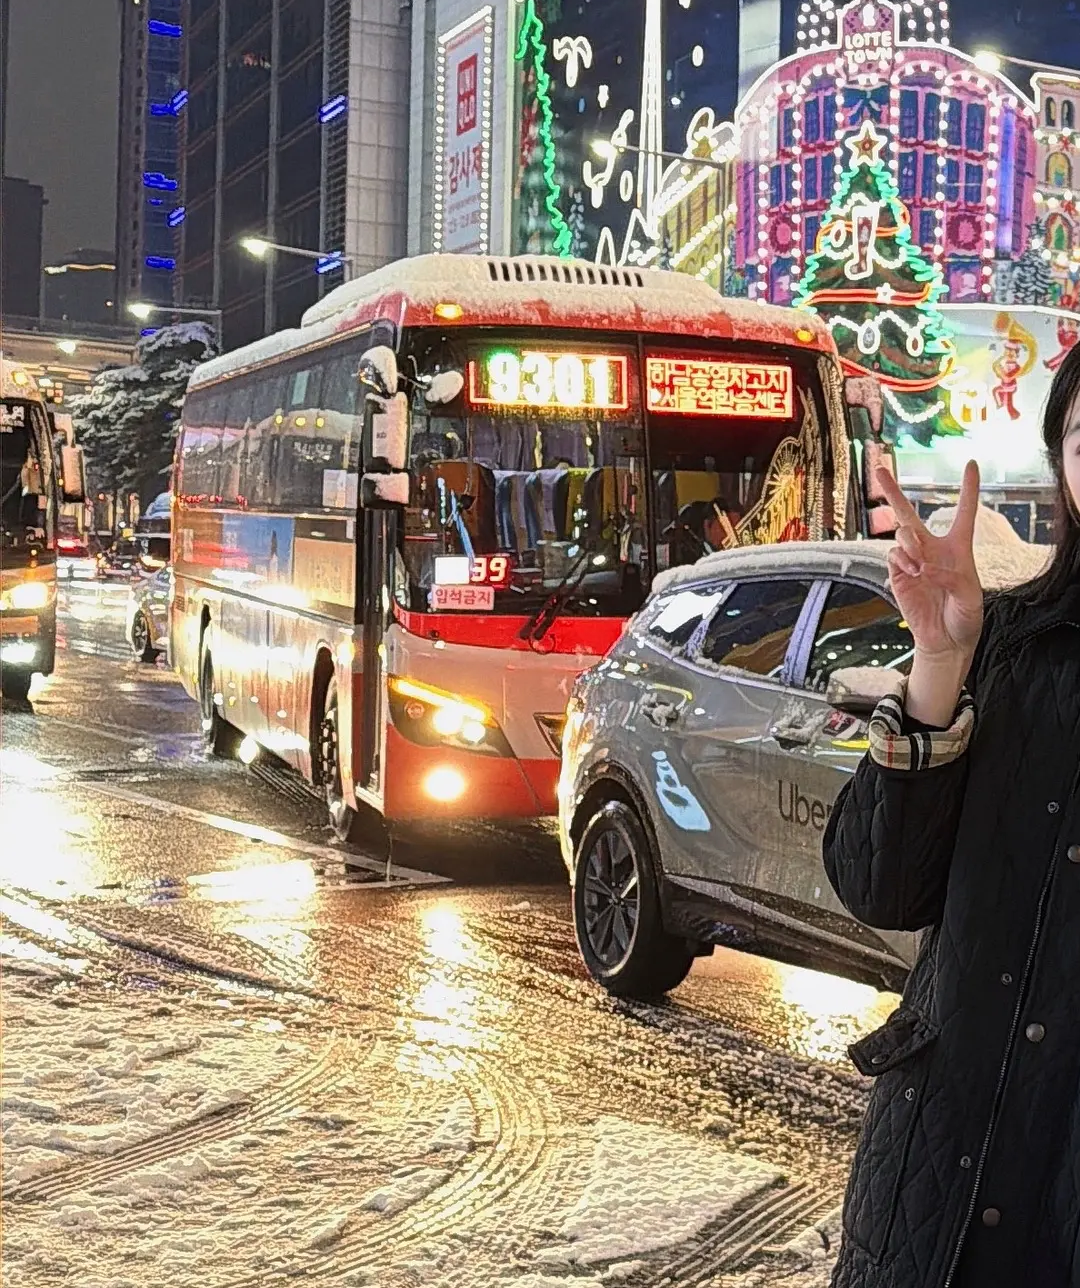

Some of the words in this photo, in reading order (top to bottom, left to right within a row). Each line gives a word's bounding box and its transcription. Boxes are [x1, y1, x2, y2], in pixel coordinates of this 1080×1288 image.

[844, 30, 892, 49] LOTTE
[843, 47, 893, 64] TOWN
[488, 352, 609, 406] 9301
[651, 361, 786, 392] 하남공영차고지
[435, 589, 491, 605] 입석금지
